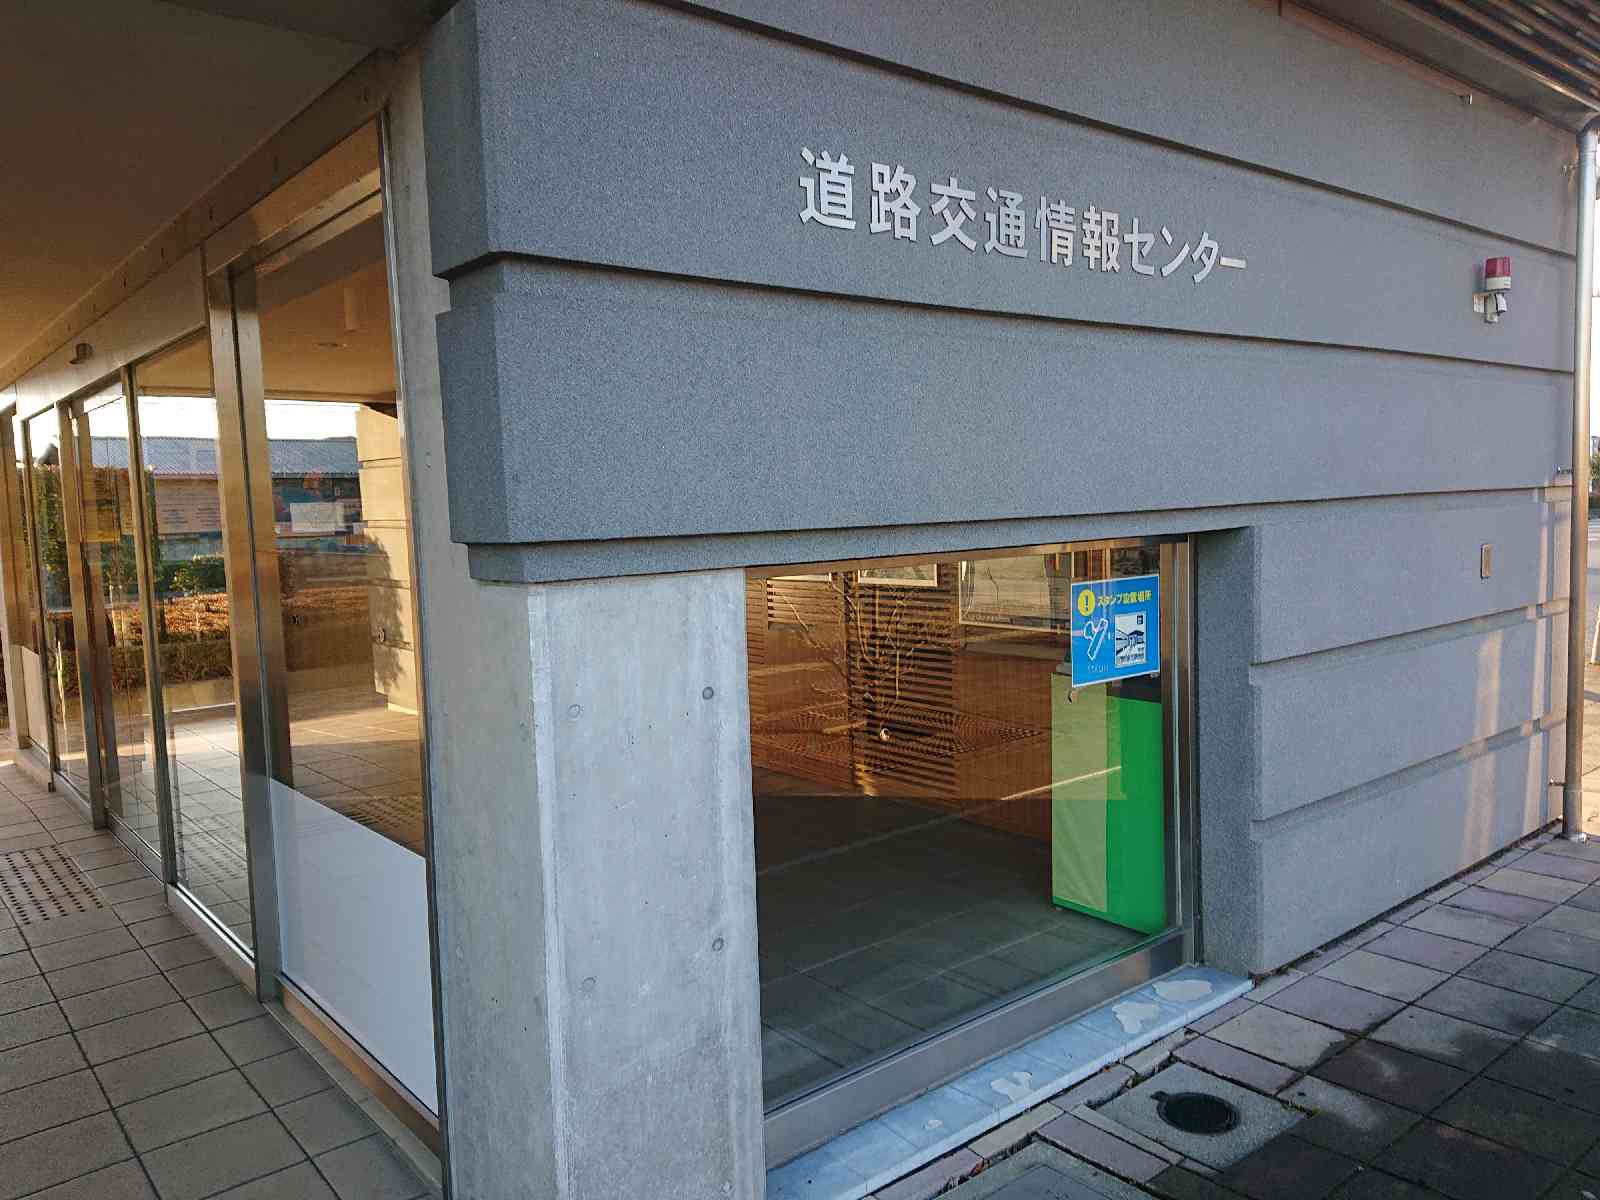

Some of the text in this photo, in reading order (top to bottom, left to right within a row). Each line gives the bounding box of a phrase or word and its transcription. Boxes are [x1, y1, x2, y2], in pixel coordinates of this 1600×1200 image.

[799, 147, 1247, 283] 道路交通情報センター
